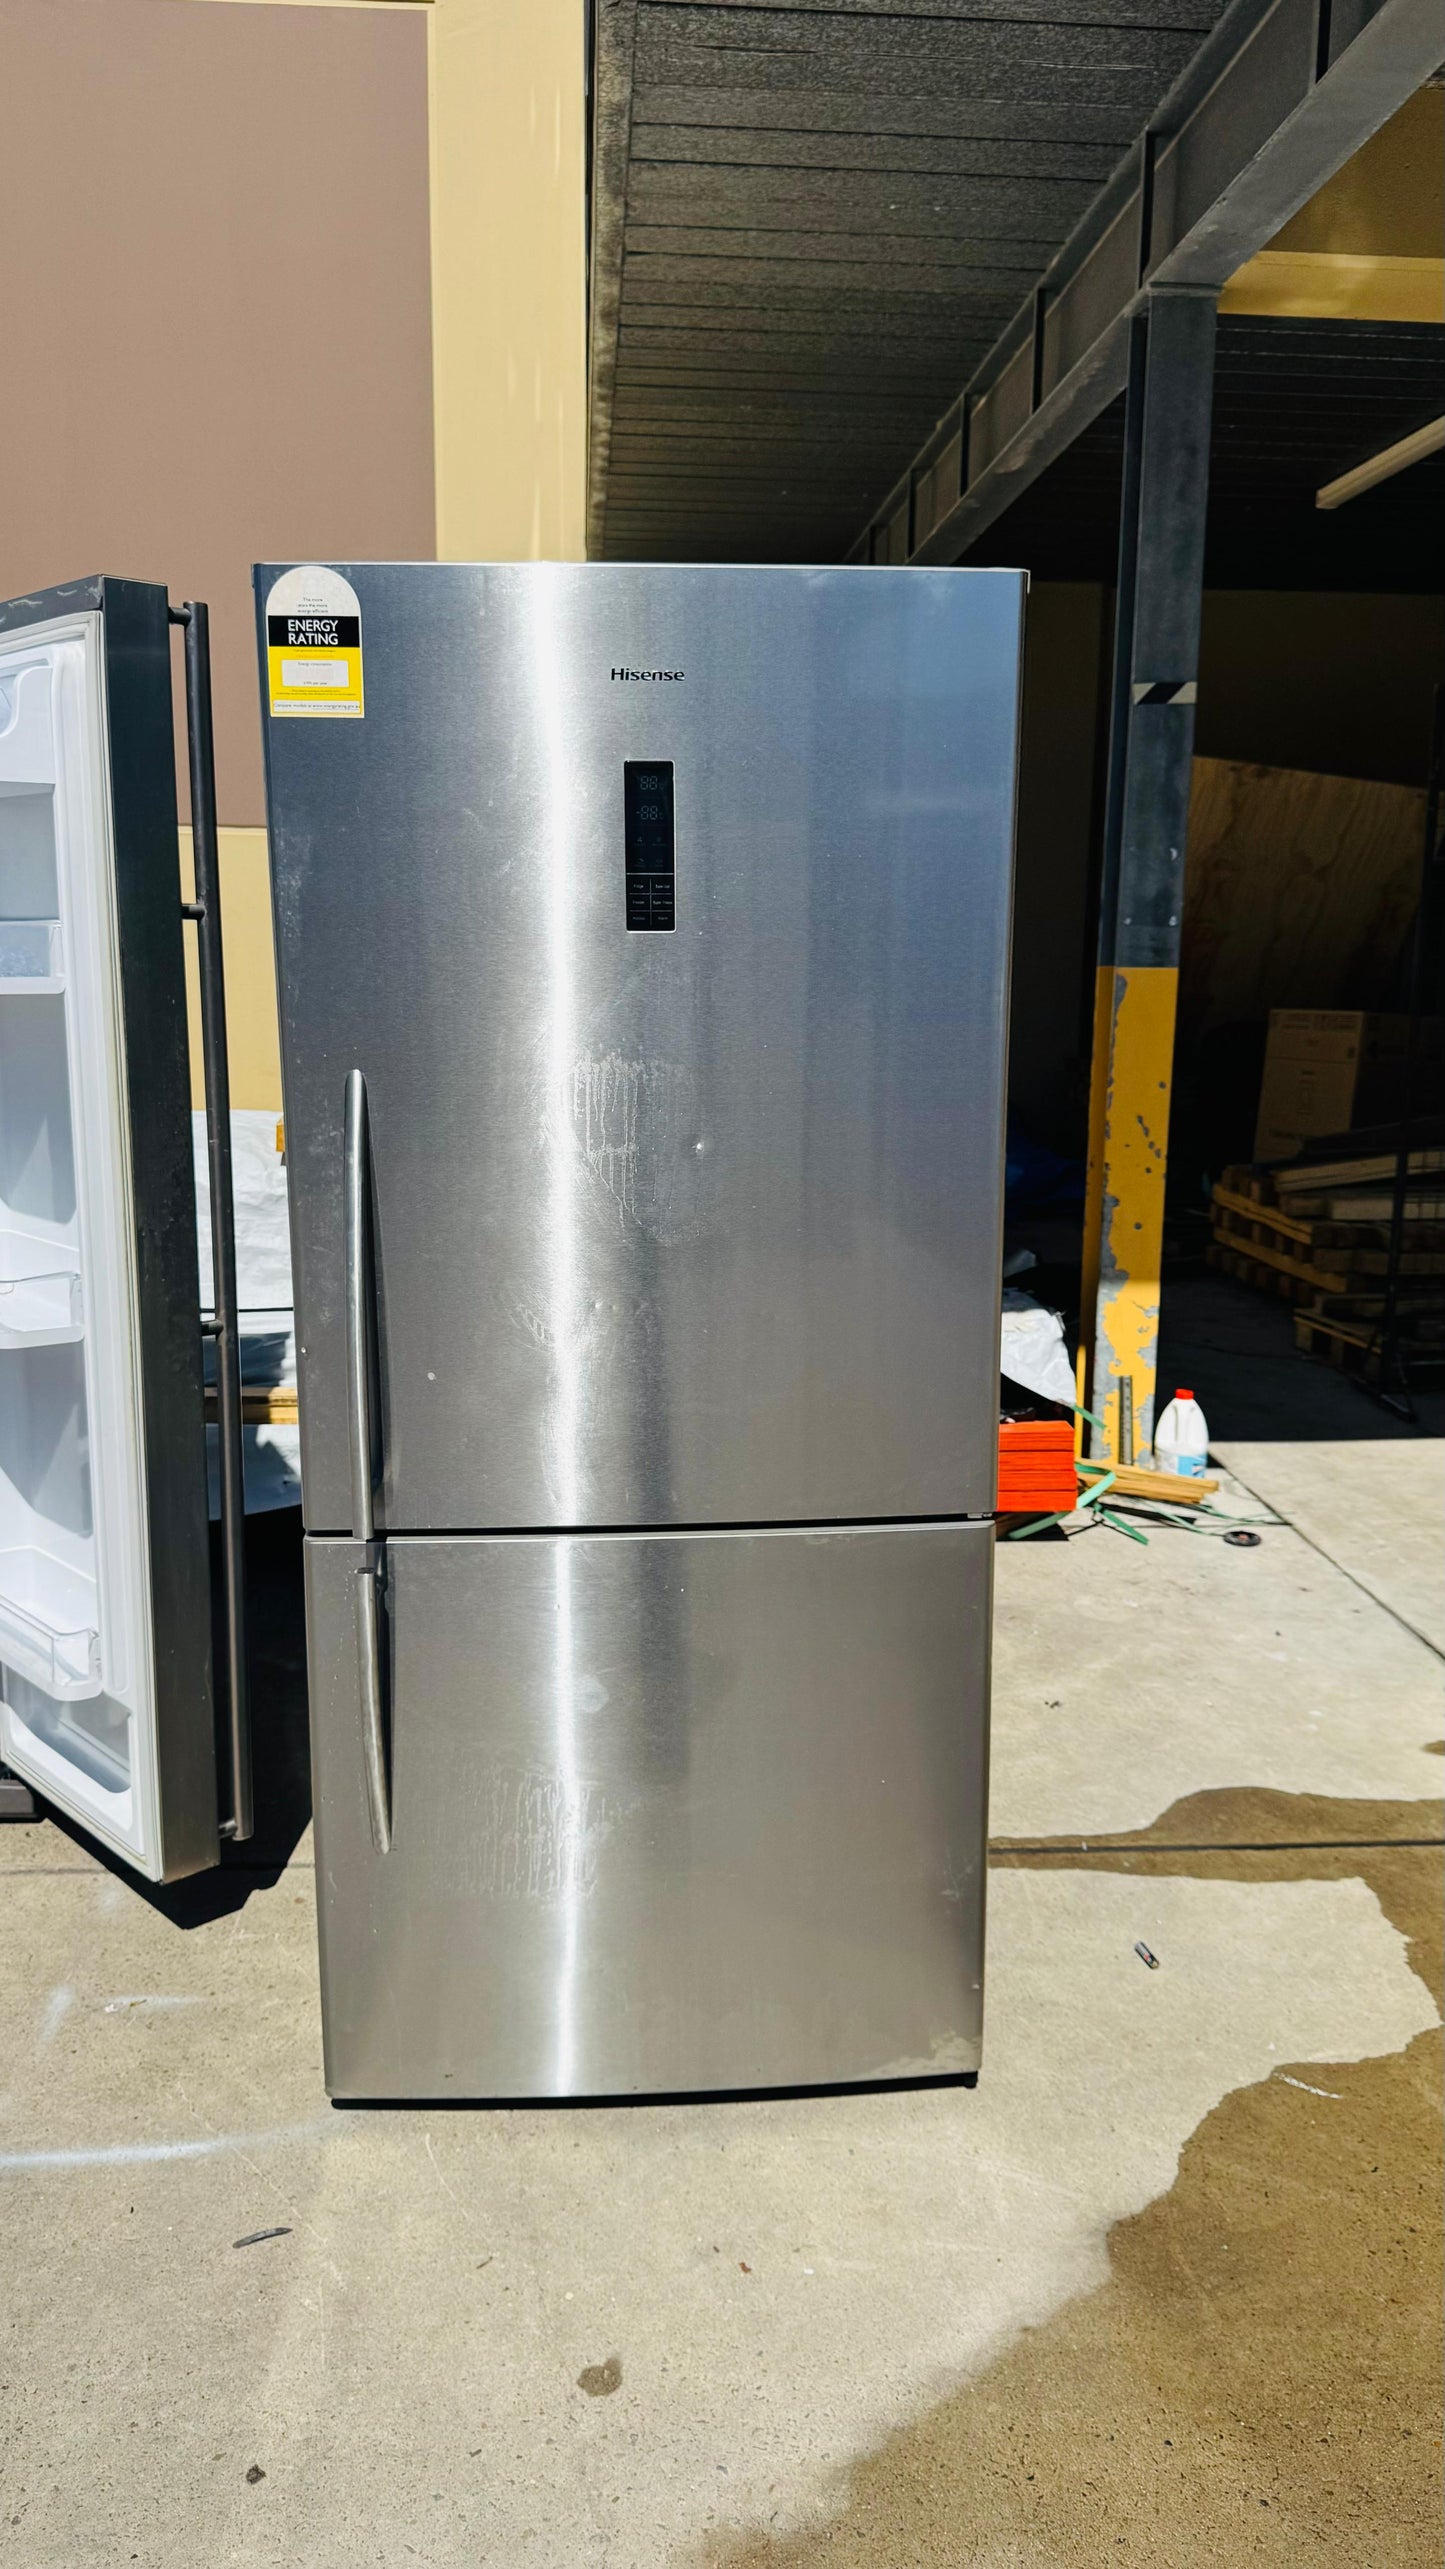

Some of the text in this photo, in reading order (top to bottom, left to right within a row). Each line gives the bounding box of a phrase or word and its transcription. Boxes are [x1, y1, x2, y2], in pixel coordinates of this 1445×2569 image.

[288, 619, 338, 632] ENERGY
[288, 633, 338, 646] RATING
[611, 667, 685, 681] Hisense
